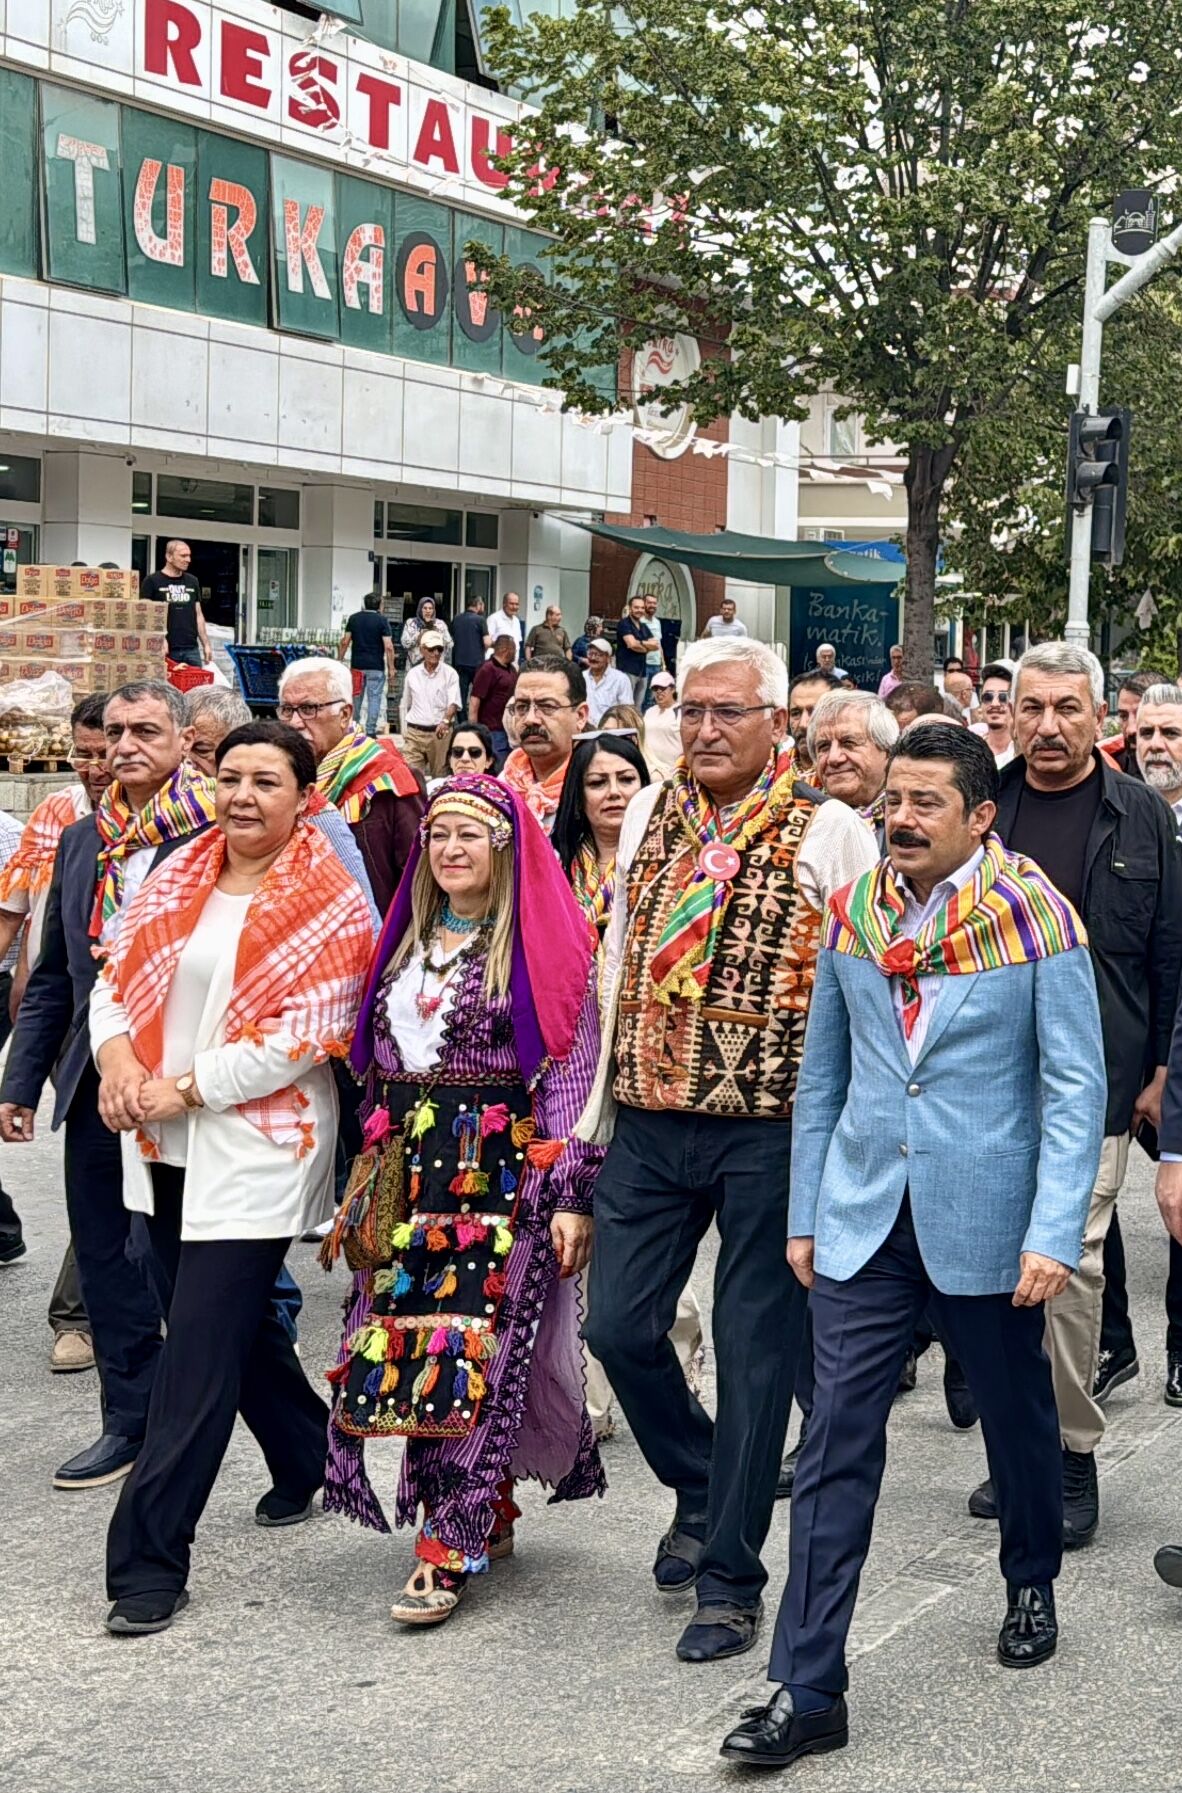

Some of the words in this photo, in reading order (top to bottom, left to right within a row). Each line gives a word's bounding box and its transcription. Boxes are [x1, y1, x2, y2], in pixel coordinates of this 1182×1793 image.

[56, 132, 385, 315] TURKA
[166, 592, 191, 602] LOUD
[808, 592, 889, 622] Banka-
[806, 623, 882, 647] matik.
